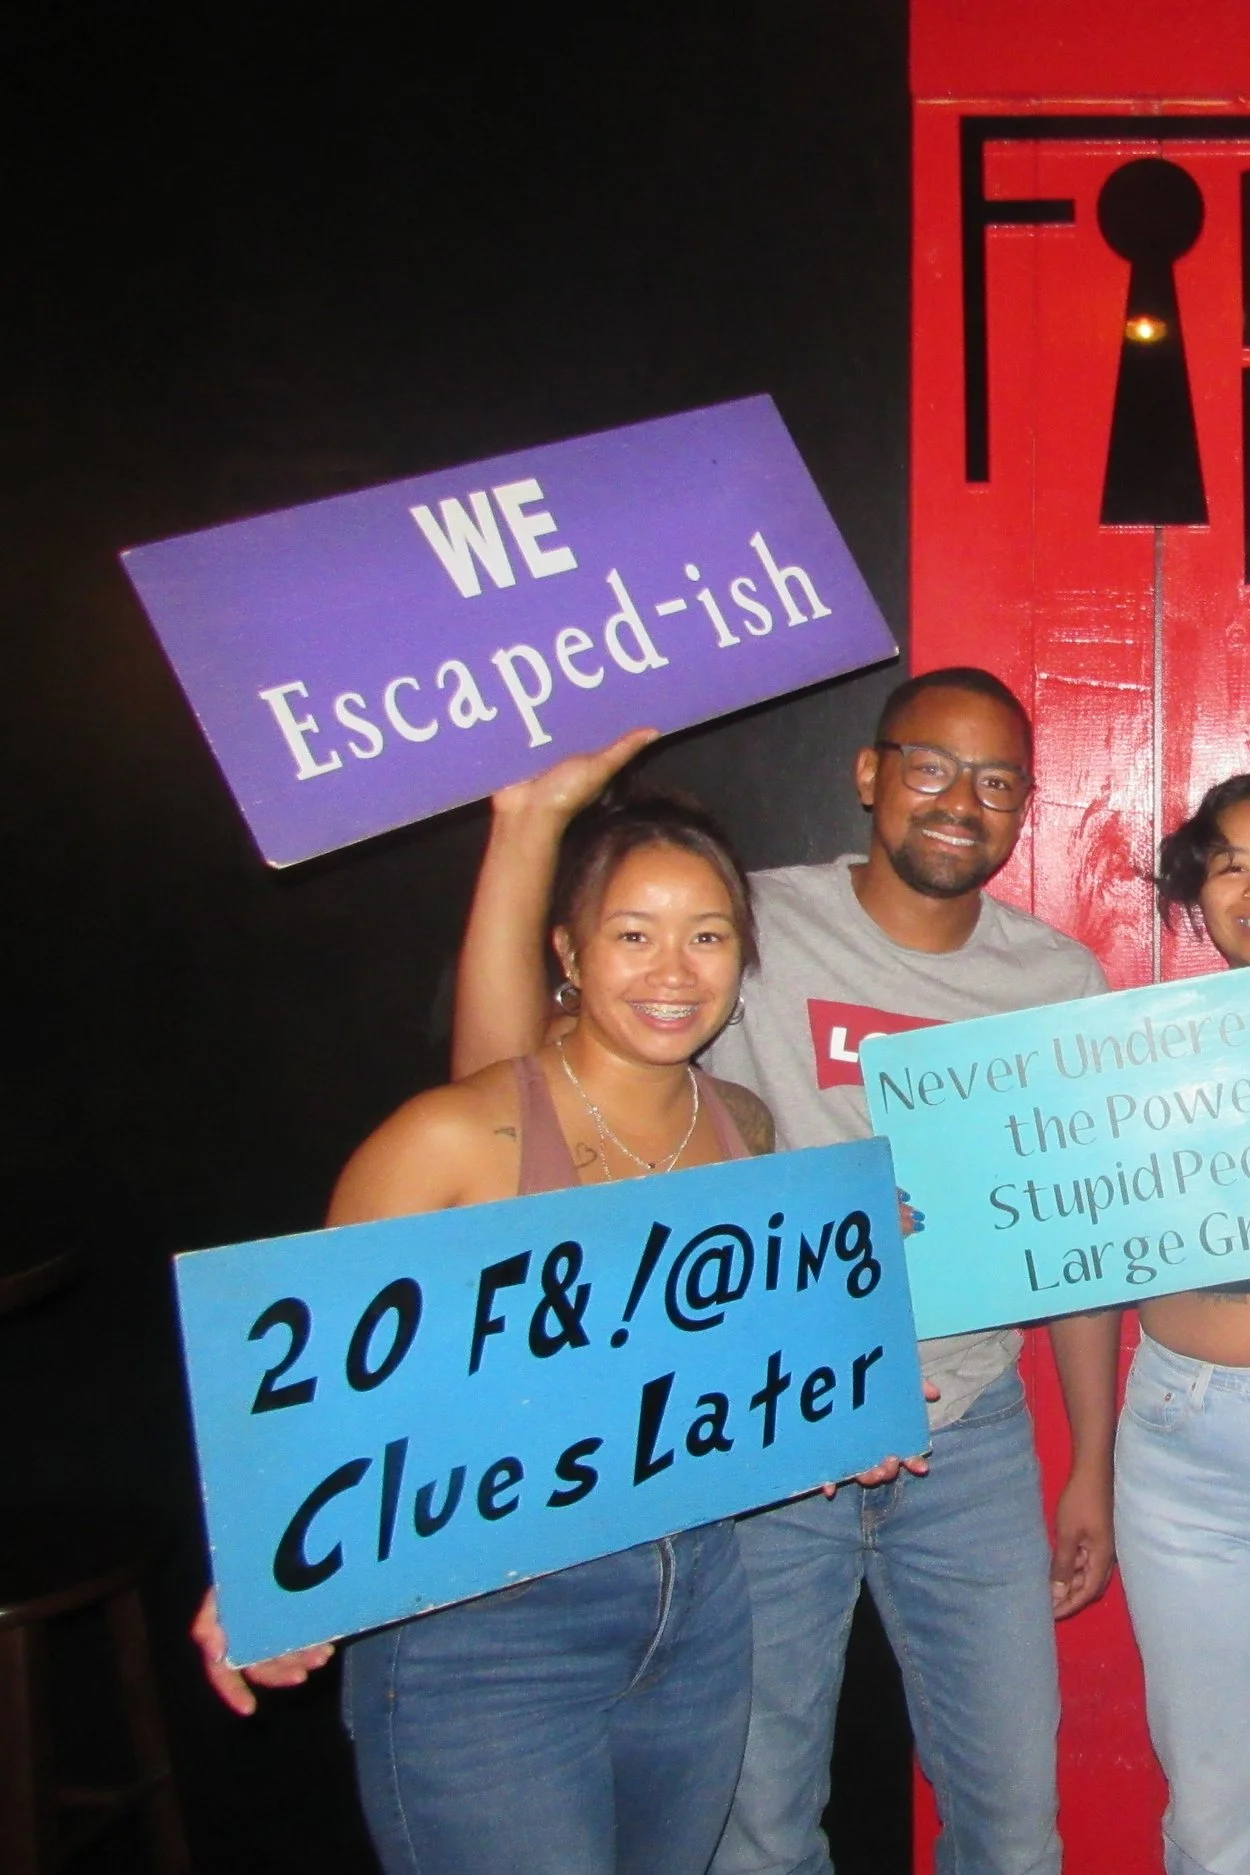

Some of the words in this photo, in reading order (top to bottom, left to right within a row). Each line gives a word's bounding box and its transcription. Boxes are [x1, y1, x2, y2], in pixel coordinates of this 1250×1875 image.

[410, 477, 579, 599] WE
[259, 531, 832, 781] Escaped-ish
[878, 1048, 1040, 1114] Never
[1004, 1106, 1098, 1158] the
[989, 1152, 1166, 1231] Stupid
[1024, 1228, 1185, 1292] Large
[245, 1276, 424, 1415] 20
[271, 1435, 605, 1593] Clues
[632, 1345, 885, 1487] Later
